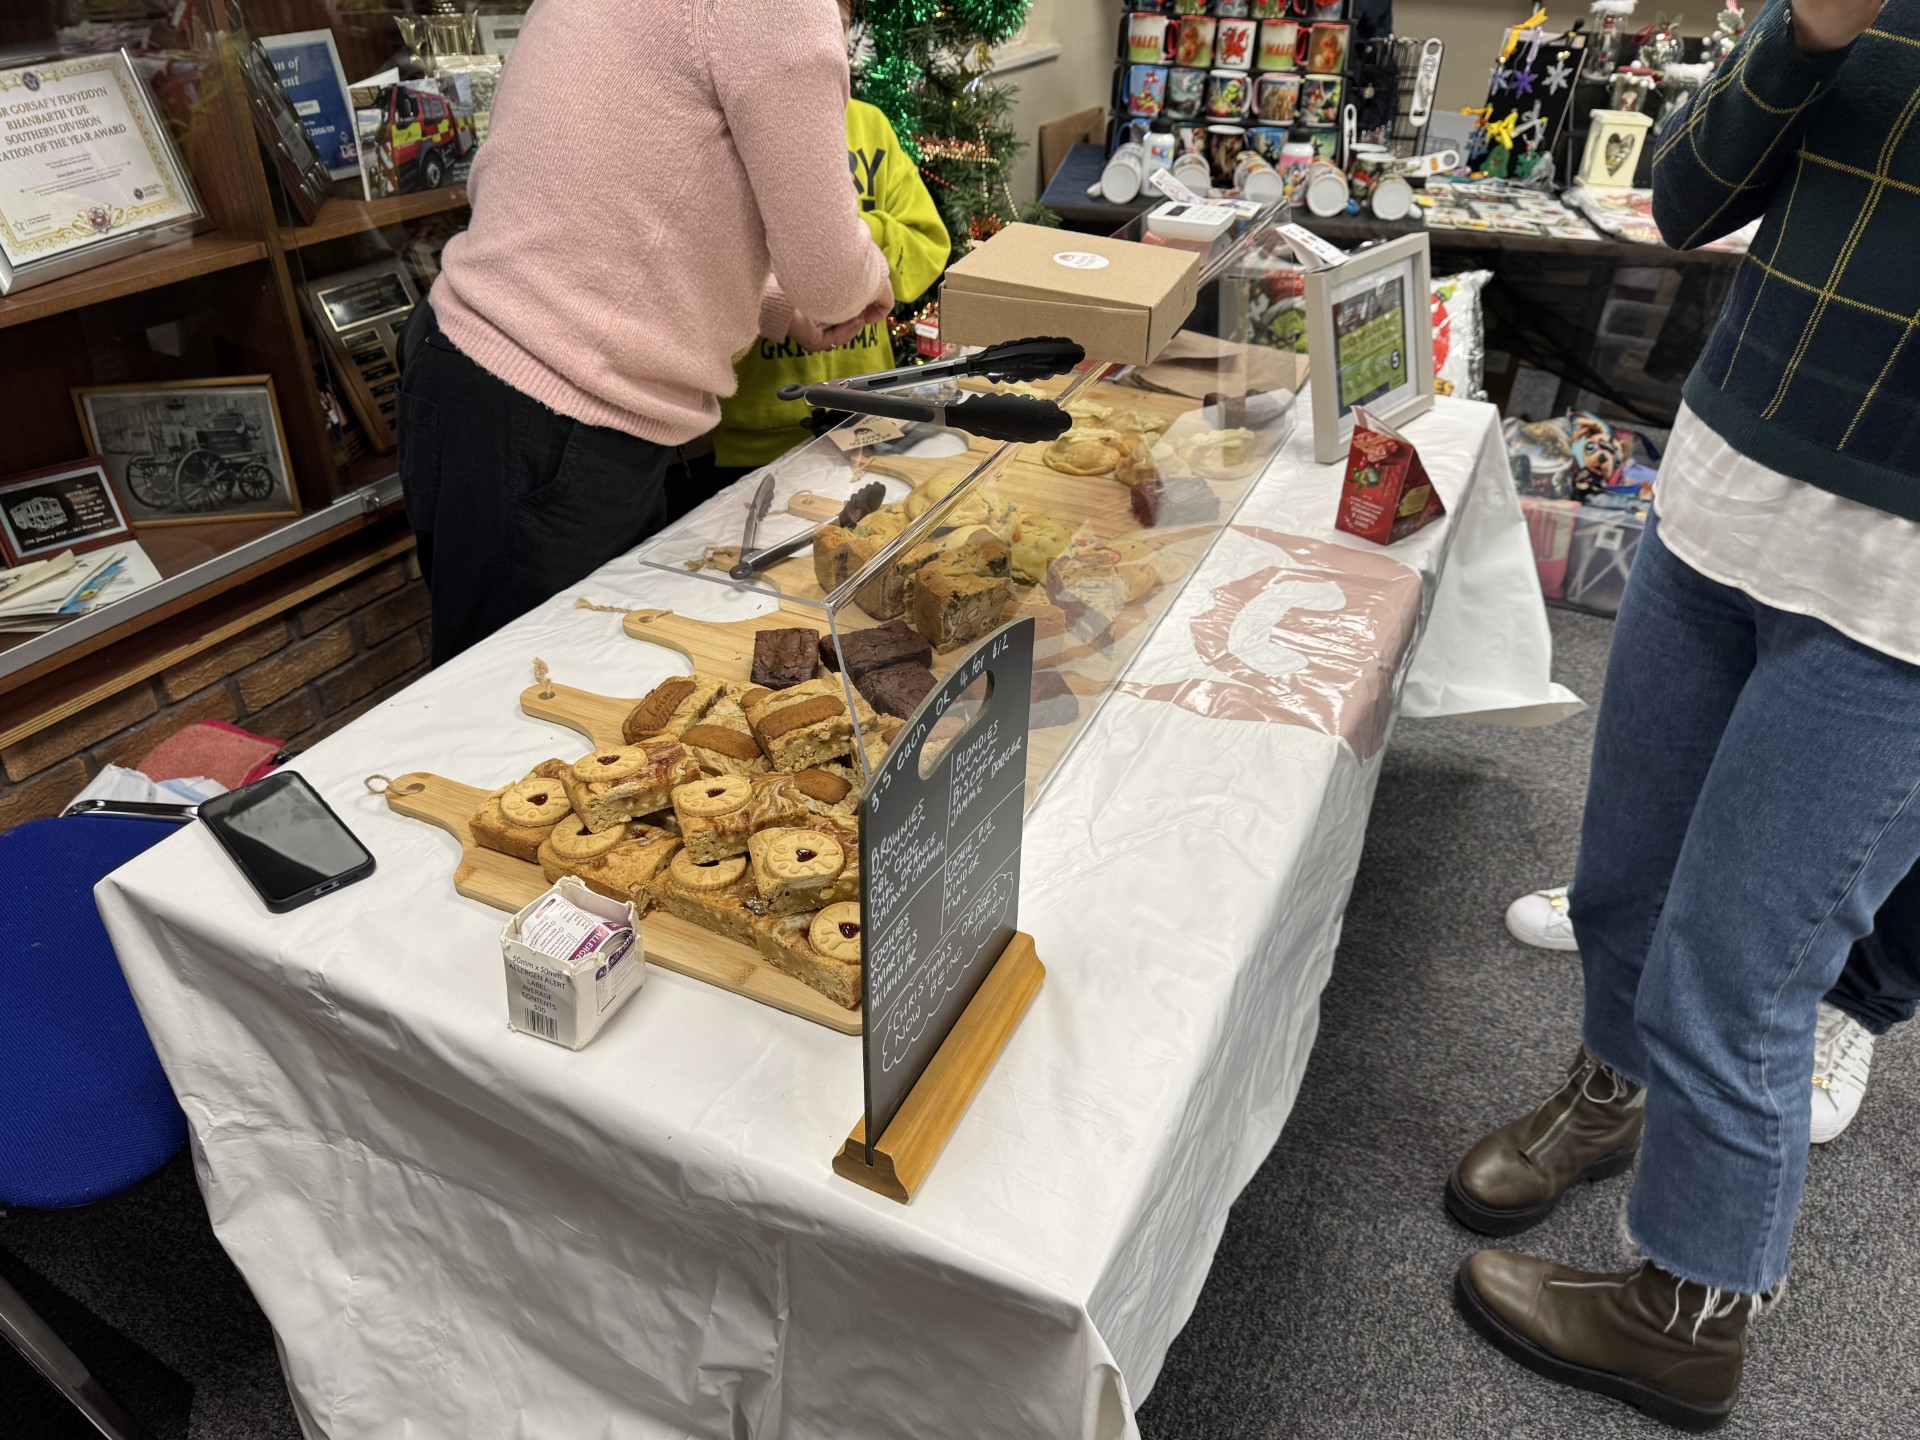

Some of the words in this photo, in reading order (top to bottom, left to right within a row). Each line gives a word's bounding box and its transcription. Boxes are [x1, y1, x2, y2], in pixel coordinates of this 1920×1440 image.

[6, 109, 67, 130] RHANBARTH
[66, 107, 75, 118] Y
[75, 104, 89, 116] DE
[10, 99, 48, 115] GORSAF
[48, 97, 56, 107] Y
[57, 86, 108, 105] FLWYDDYN
[0, 145, 34, 162] ATION
[34, 142, 48, 153] OF
[47, 136, 69, 151] THE
[66, 131, 94, 147] YEAR
[93, 123, 127, 140] AWARD
[5, 124, 58, 146] SOUTHERN
[58, 115, 102, 134] DIVISION
[896, 723, 927, 771] each
[935, 689, 951, 716] OR
[956, 719, 999, 773] BLONDIES
[952, 748, 996, 806] BISCOFF
[871, 797, 925, 876] BROWNIES
[900, 831, 937, 882] ORANGE
[870, 873, 890, 904] DBL
[893, 839, 920, 873] CHOC
[871, 912, 910, 969] COOKIES
[872, 928, 918, 994] SMARTIES
[509, 963, 544, 983] ALLERGEN
[544, 976, 566, 990] ALERT
[522, 984, 553, 1001] AVERAGE
[526, 977, 548, 992] LABEL
[895, 1004, 921, 1047] NOW
[930, 945, 963, 999] BEING
[521, 990, 557, 1012] CONTENTS
[533, 1004, 546, 1015] 500
